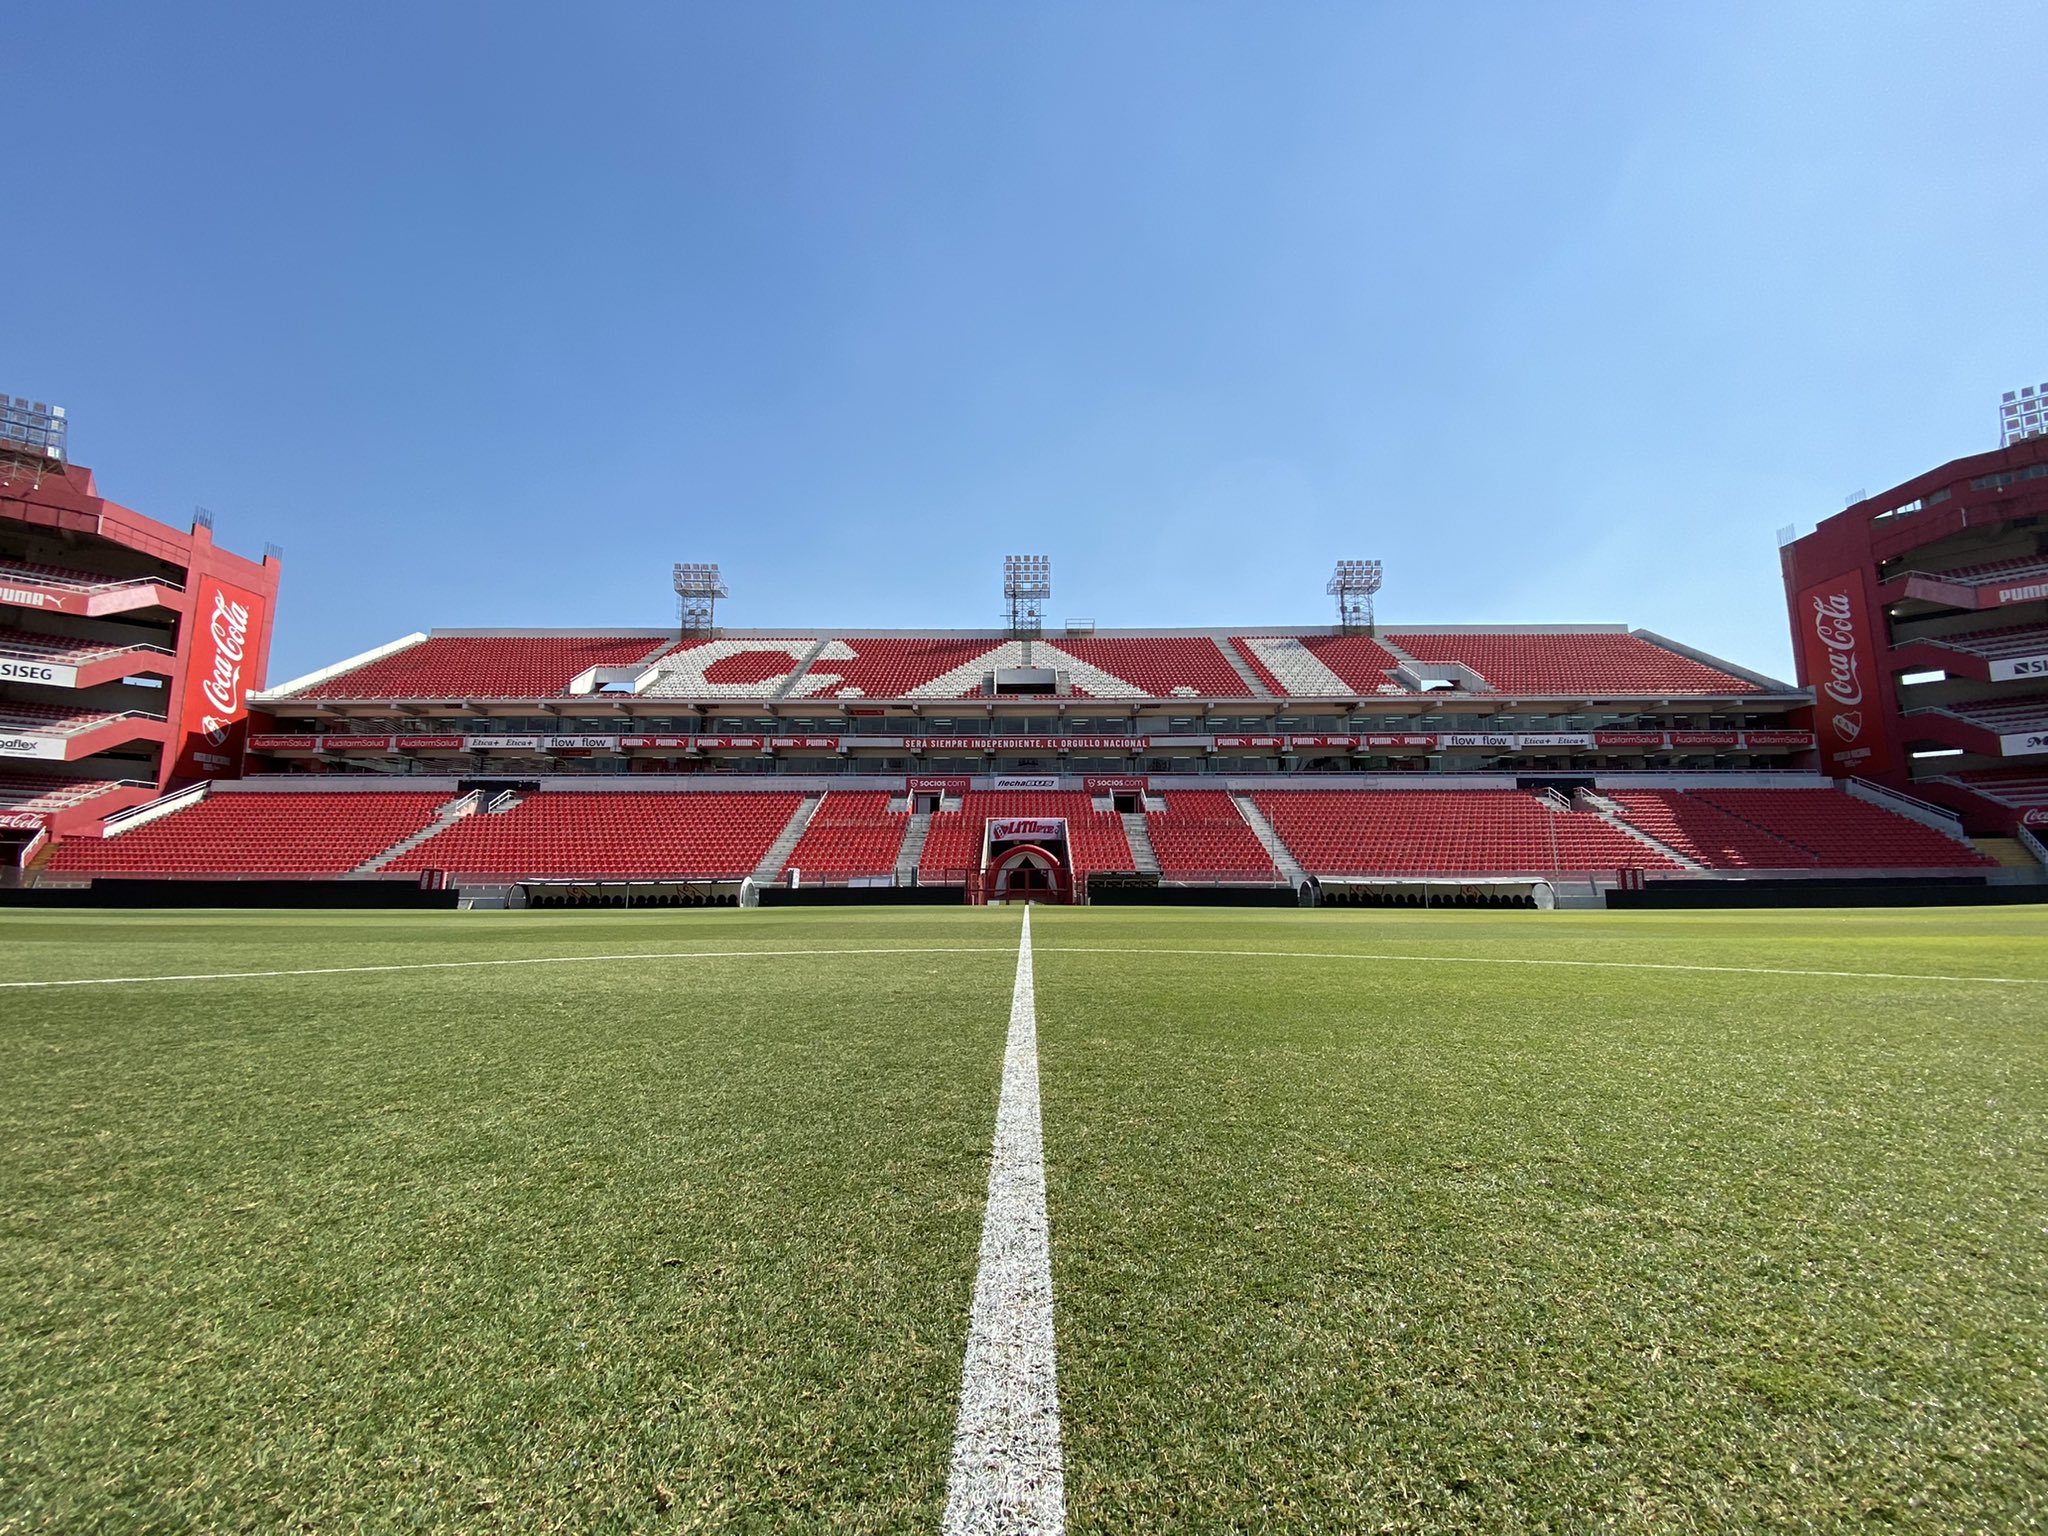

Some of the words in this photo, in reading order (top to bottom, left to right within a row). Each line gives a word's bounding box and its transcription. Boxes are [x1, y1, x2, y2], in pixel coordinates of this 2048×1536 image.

[1, 664, 52, 681] SISEG
[551, 737, 576, 748] flow
[582, 737, 606, 748] flow
[930, 739, 968, 748] SIEMPRE
[1047, 739, 1059, 748] EL
[1061, 739, 1100, 748] ORGULLO
[1103, 739, 1147, 748] NACIONAL
[1451, 735, 1475, 746] flow
[1482, 735, 1507, 746] flow
